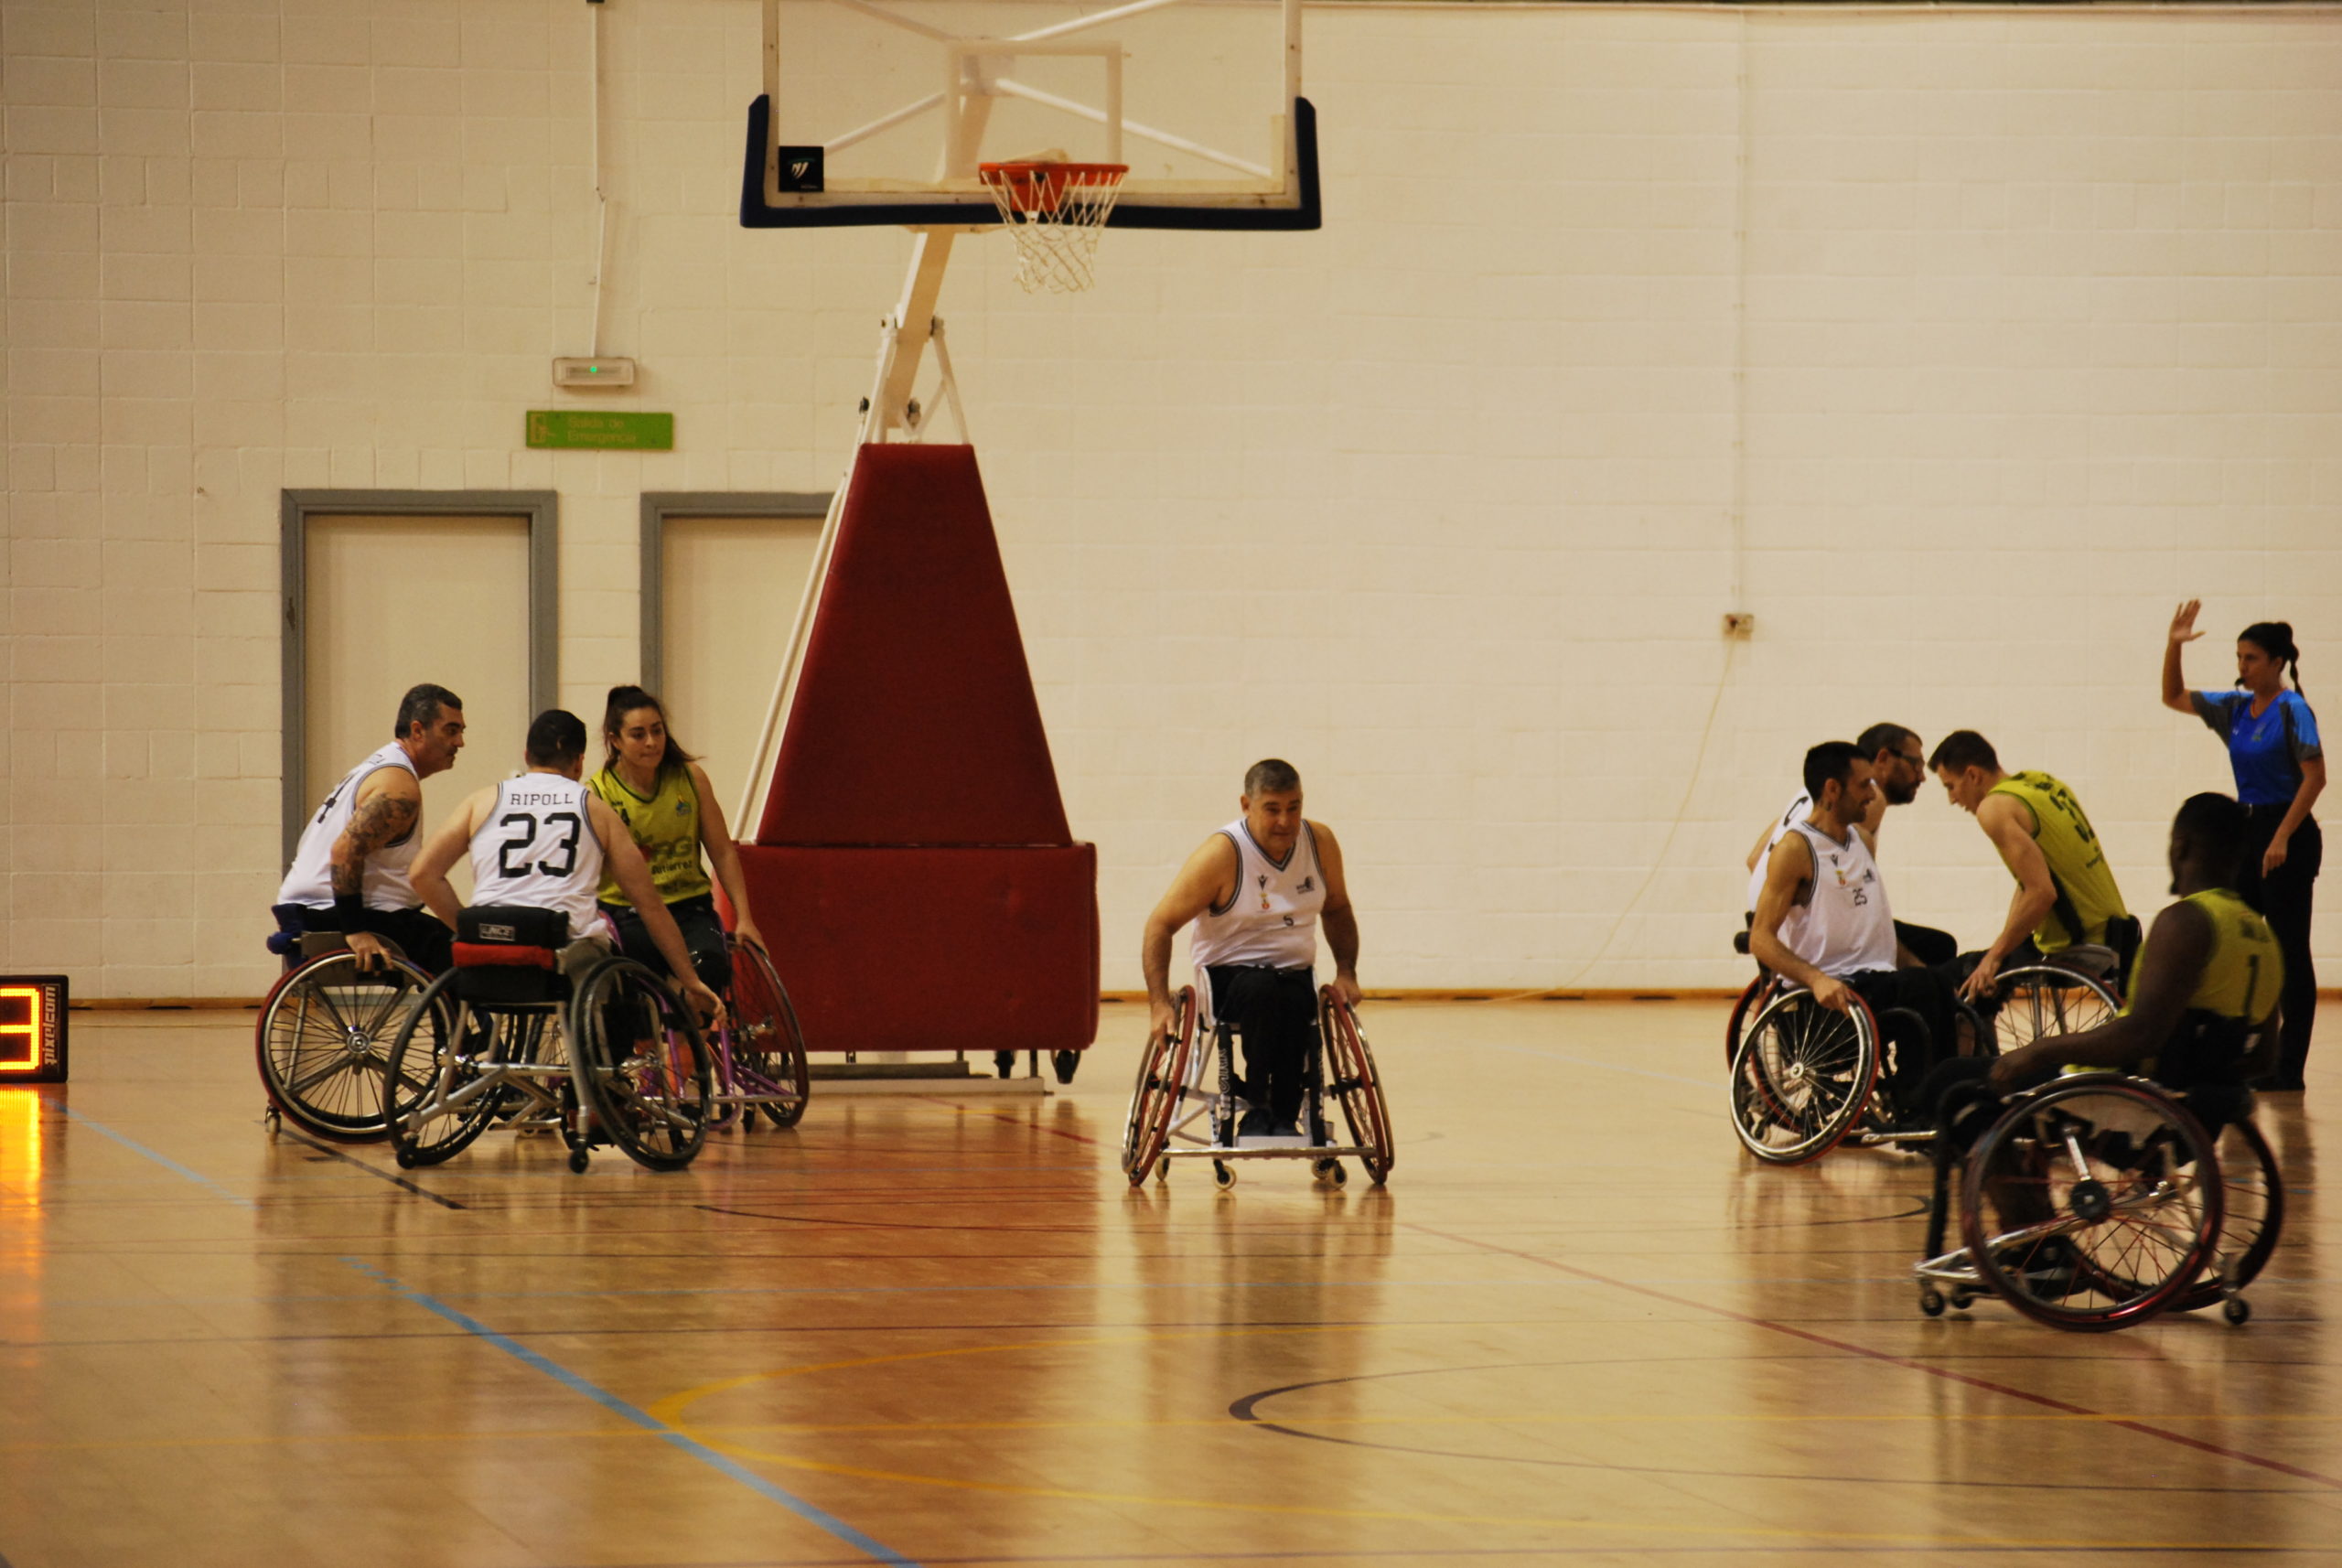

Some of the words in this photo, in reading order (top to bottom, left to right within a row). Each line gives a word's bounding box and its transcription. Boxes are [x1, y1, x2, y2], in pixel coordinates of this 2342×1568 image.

[510, 793, 574, 806] RIPOLL
[499, 811, 581, 879] 23
[42, 986, 58, 1066] pixelcom
